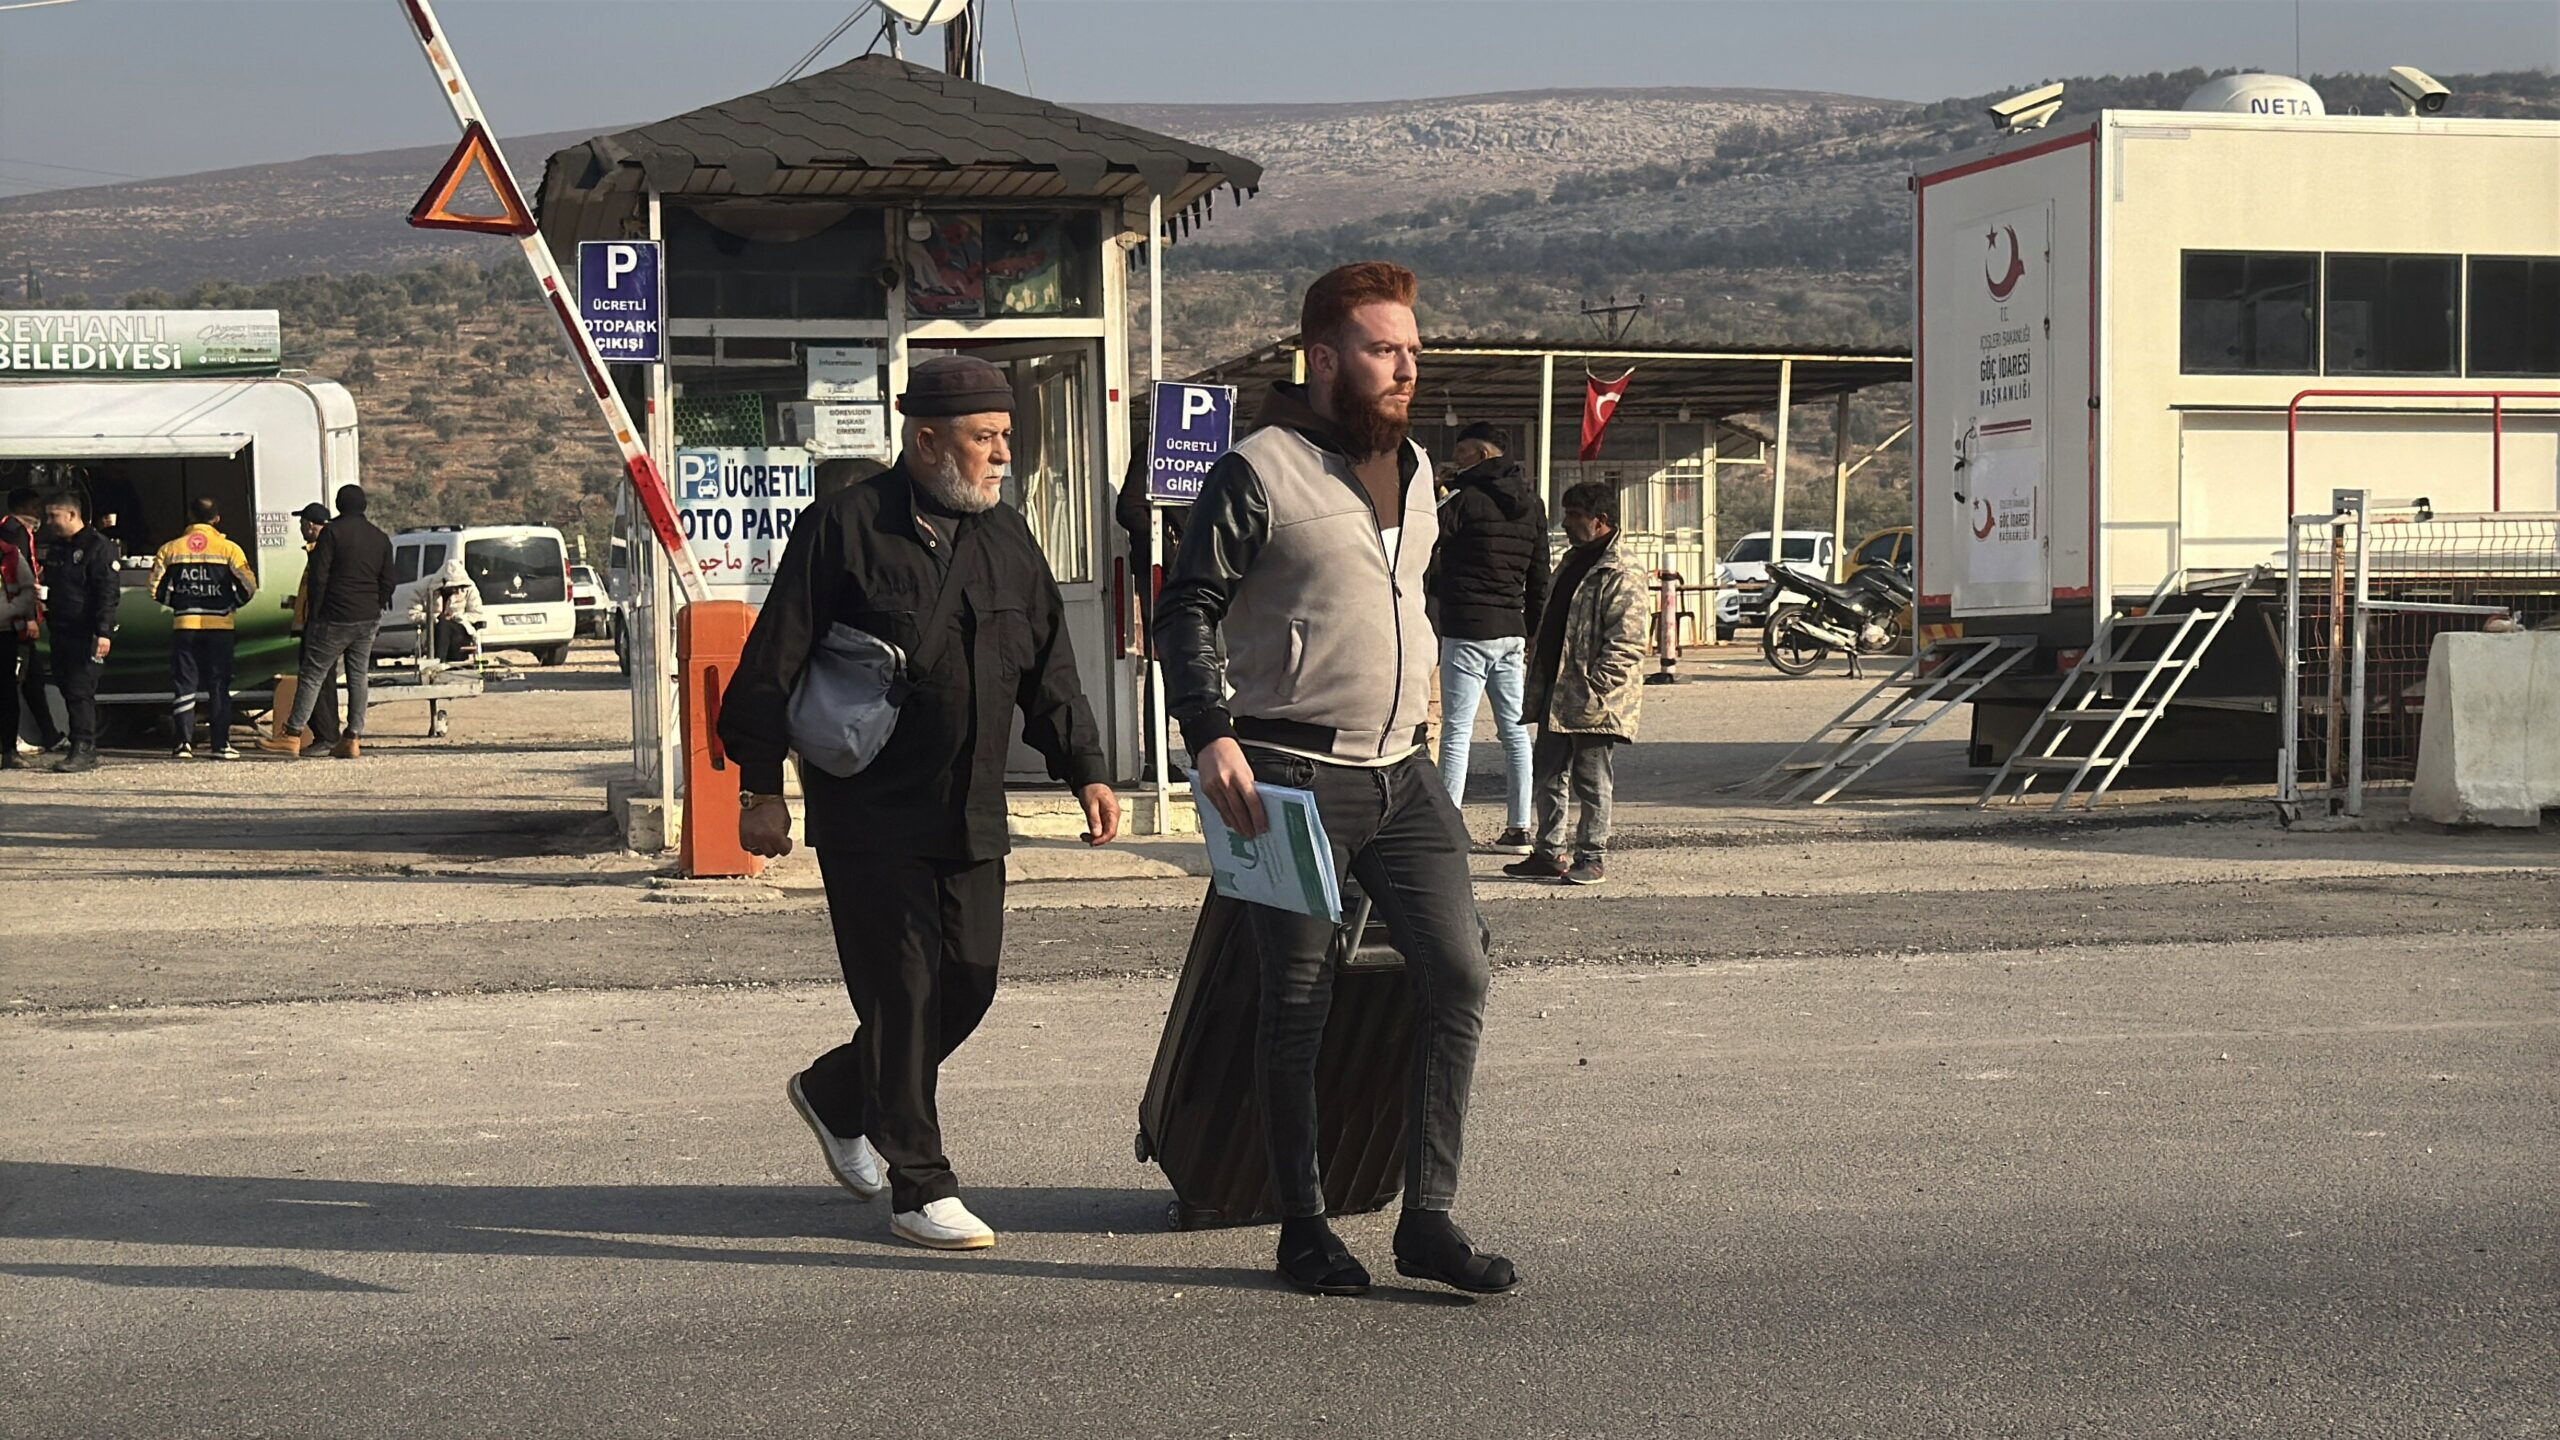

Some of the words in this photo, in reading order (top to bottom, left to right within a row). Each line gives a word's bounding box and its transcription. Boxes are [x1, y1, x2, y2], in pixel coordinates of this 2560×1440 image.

[2251, 98, 2312, 115] NETA
[607, 245, 638, 289] P
[593, 298, 647, 311] ÜCRETLİ
[0, 315, 166, 343] REYHANLI
[583, 319, 657, 333] OTOPARK
[595, 337, 644, 352] ÇIKIŞI
[1980, 355, 1997, 386] GÖÇ
[1999, 348, 2031, 378] İDARESİ
[1980, 379, 2031, 408] BAŞKANLIĞI
[1181, 387, 1215, 430] P
[1166, 438, 1218, 453] ÜCRETLİ
[724, 457, 813, 498] ÜCRETLİ
[679, 508, 733, 541] OTO
[742, 508, 801, 541] PAR
[258, 536, 285, 547] KANI
